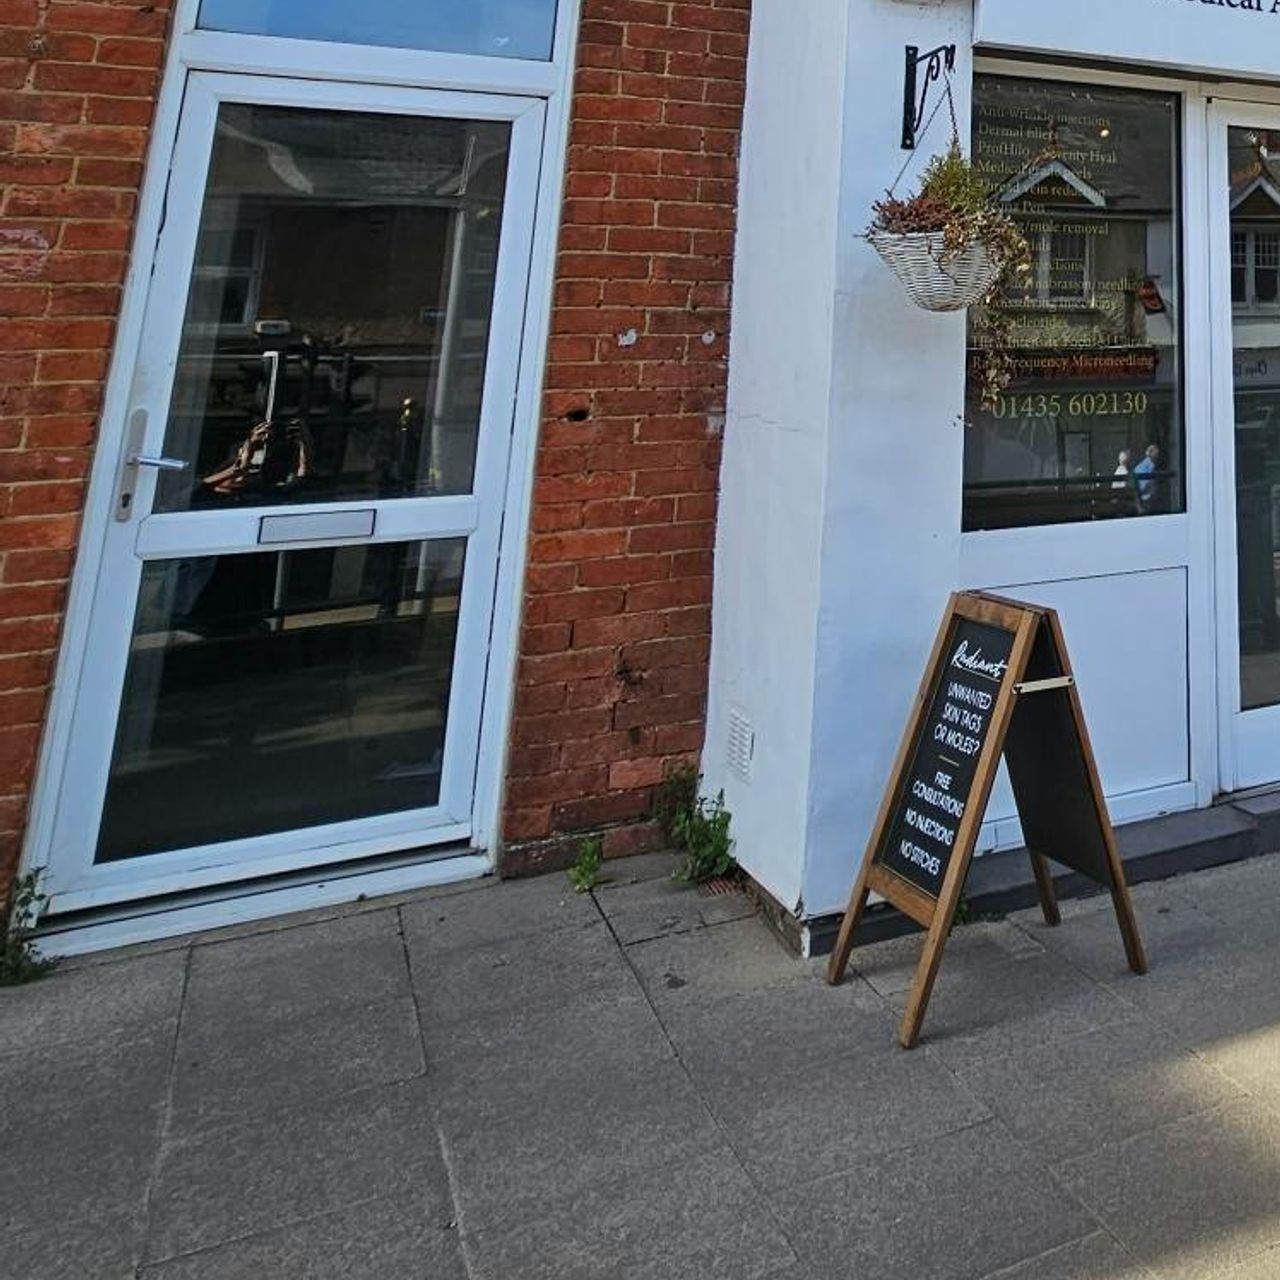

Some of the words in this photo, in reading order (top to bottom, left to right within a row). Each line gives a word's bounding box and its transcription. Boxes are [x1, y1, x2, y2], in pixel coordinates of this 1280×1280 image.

[979, 122, 1023, 138] Dermal
[1089, 150, 1118, 164] Hyal
[1062, 222, 1110, 236] removal
[992, 395, 1061, 419] 01435
[1069, 391, 1148, 416] 602130
[947, 681, 992, 710] UNWANTED
[942, 702, 960, 725] SKIN
[961, 709, 983, 734] TAGS
[934, 723, 947, 743] OR
[945, 729, 980, 757] MOLES?
[934, 771, 952, 790] FREE
[905, 807, 917, 826] NO
[900, 839, 913, 859] NO
